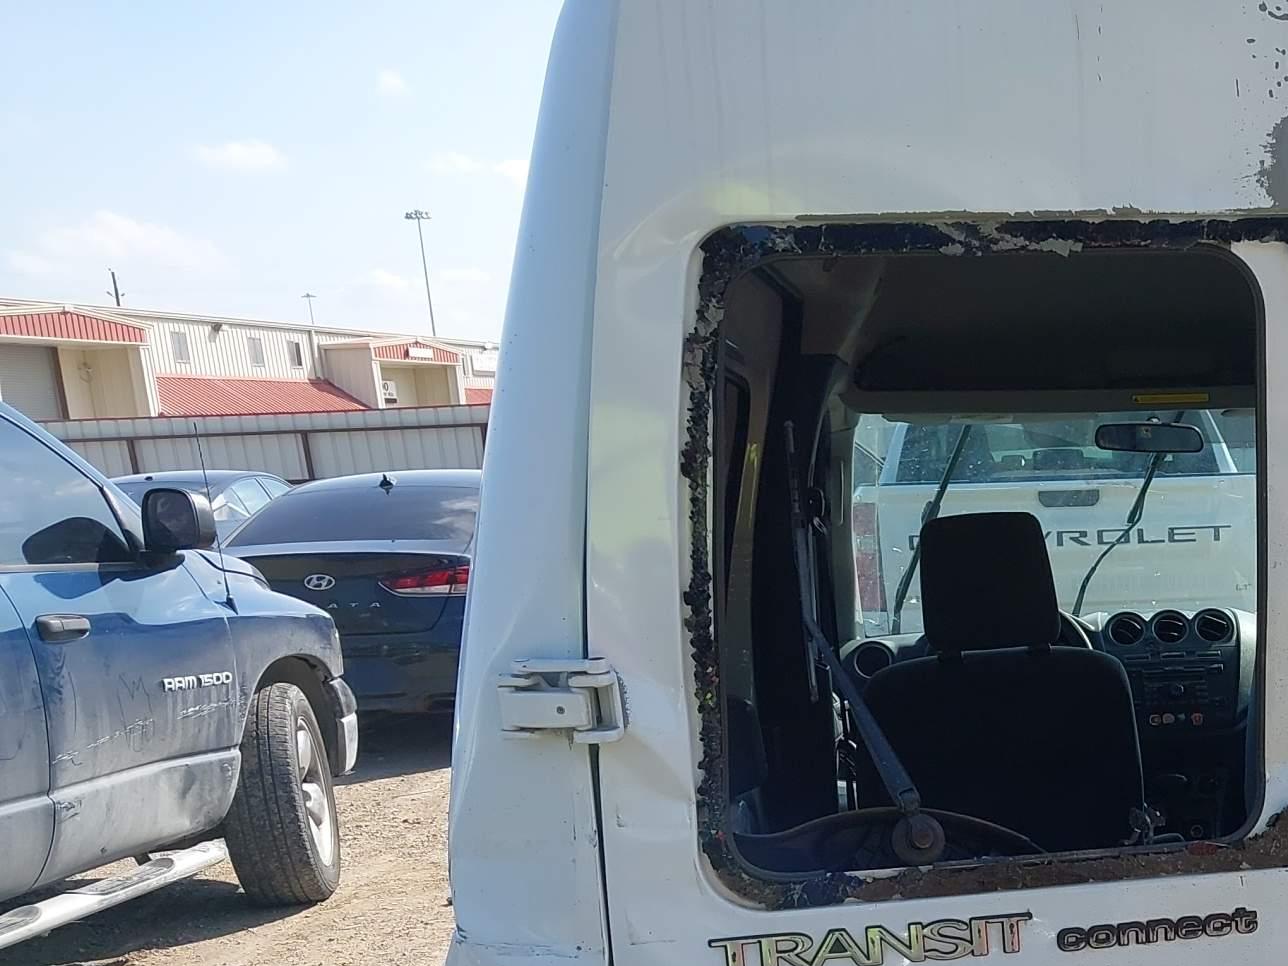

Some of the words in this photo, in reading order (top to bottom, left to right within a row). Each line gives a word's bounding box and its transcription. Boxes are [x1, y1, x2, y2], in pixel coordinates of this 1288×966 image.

[908, 524, 1232, 552] ROLET
[161, 676, 198, 693] RAM
[199, 671, 233, 688] 1500
[1057, 907, 1258, 951] connect
